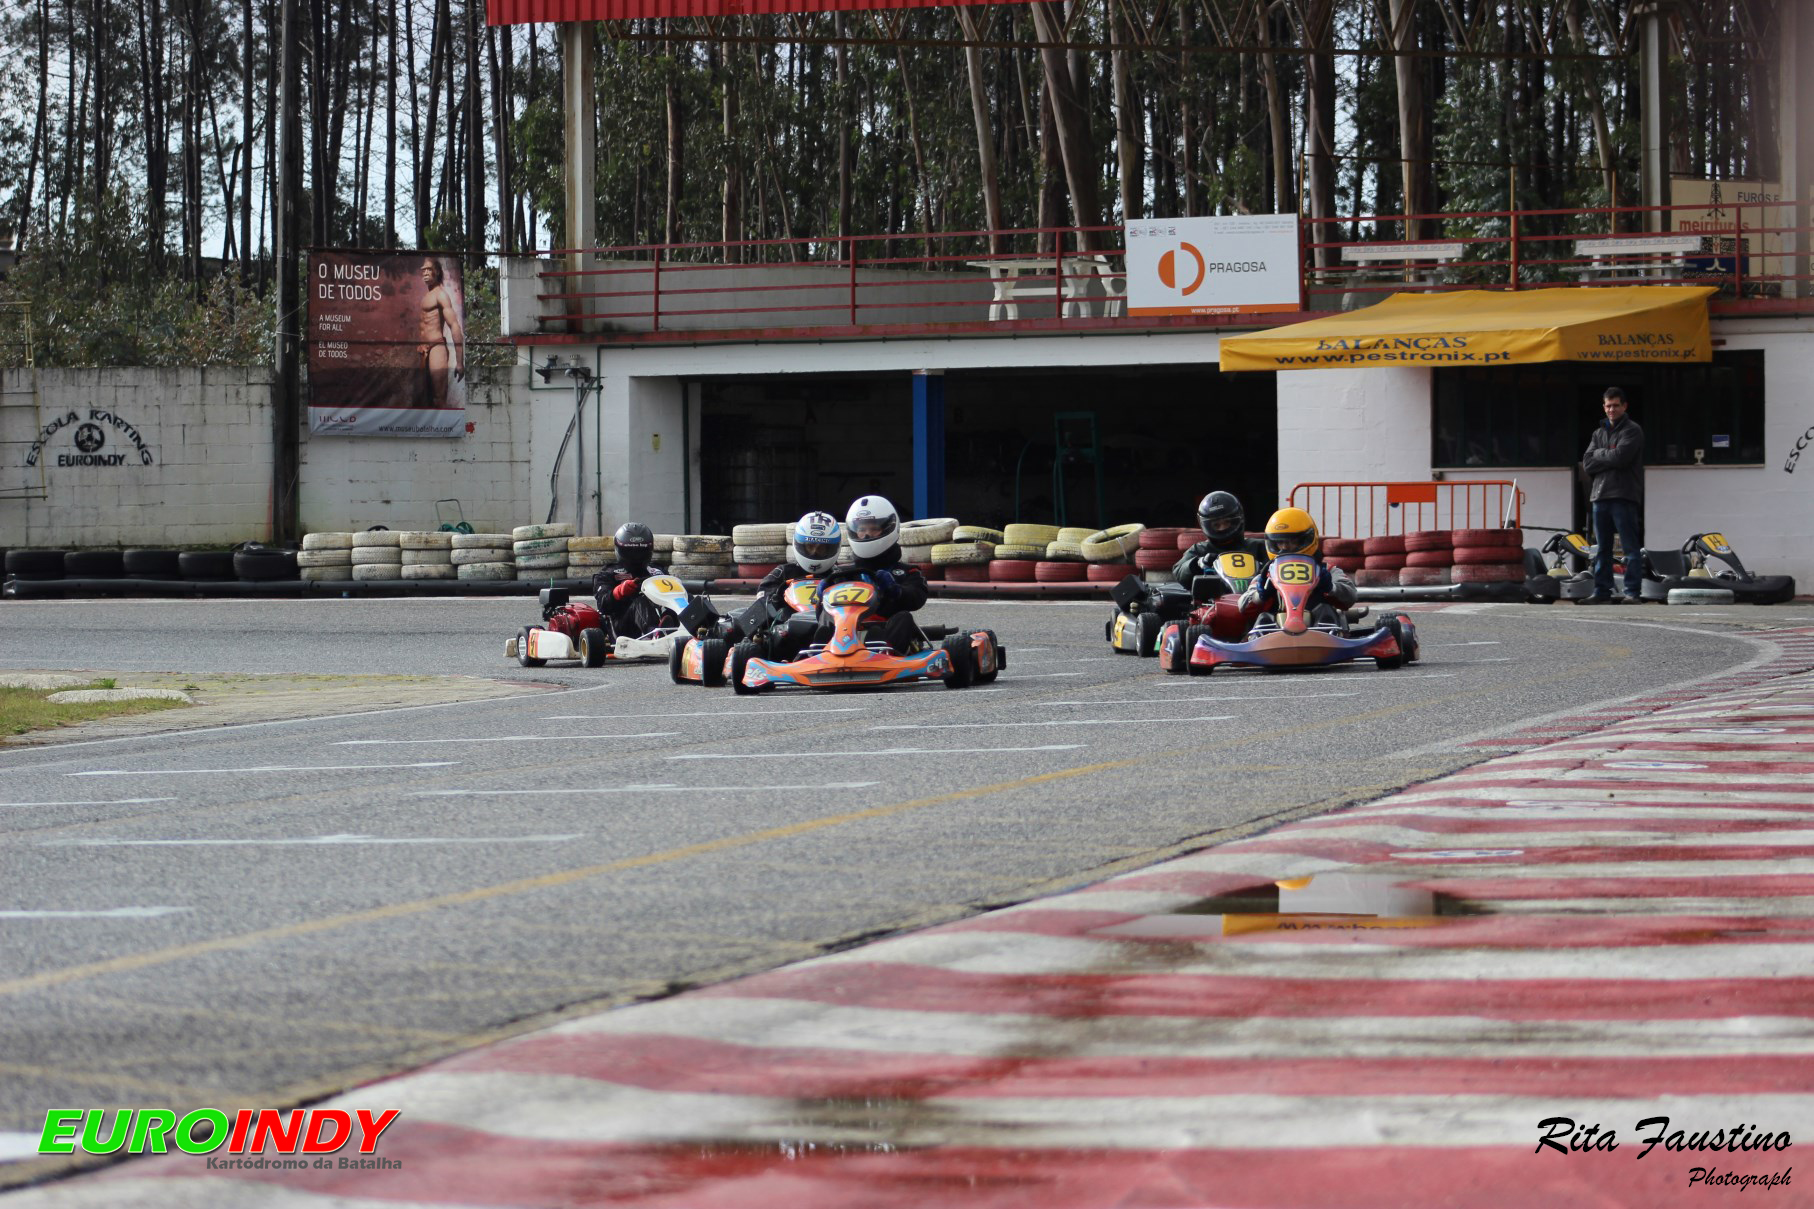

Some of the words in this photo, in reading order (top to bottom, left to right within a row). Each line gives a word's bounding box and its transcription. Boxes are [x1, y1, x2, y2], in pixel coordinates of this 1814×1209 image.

[1737, 191, 1771, 203] FUROS
[318, 263, 328, 279] O
[334, 264, 380, 280] MUSEU
[1209, 261, 1267, 274] PRAGOSA
[319, 283, 335, 299] DE
[338, 284, 382, 301] TODOS
[319, 314, 324, 322] A
[325, 315, 351, 323] MUSEUM
[319, 323, 331, 331] FOR
[332, 323, 343, 332] ALL
[1598, 333, 1674, 347] BALANÇAS
[1274, 351, 1511, 365] www.pestronix.pt
[26, 411, 79, 467] ESCOLA
[89, 409, 153, 466] KARTING
[57, 454, 126, 467] EUROINDY
[1231, 554, 1246, 568] 8
[1280, 563, 1310, 581] 63
[661, 579, 674, 592] 9
[833, 588, 866, 603] 67
